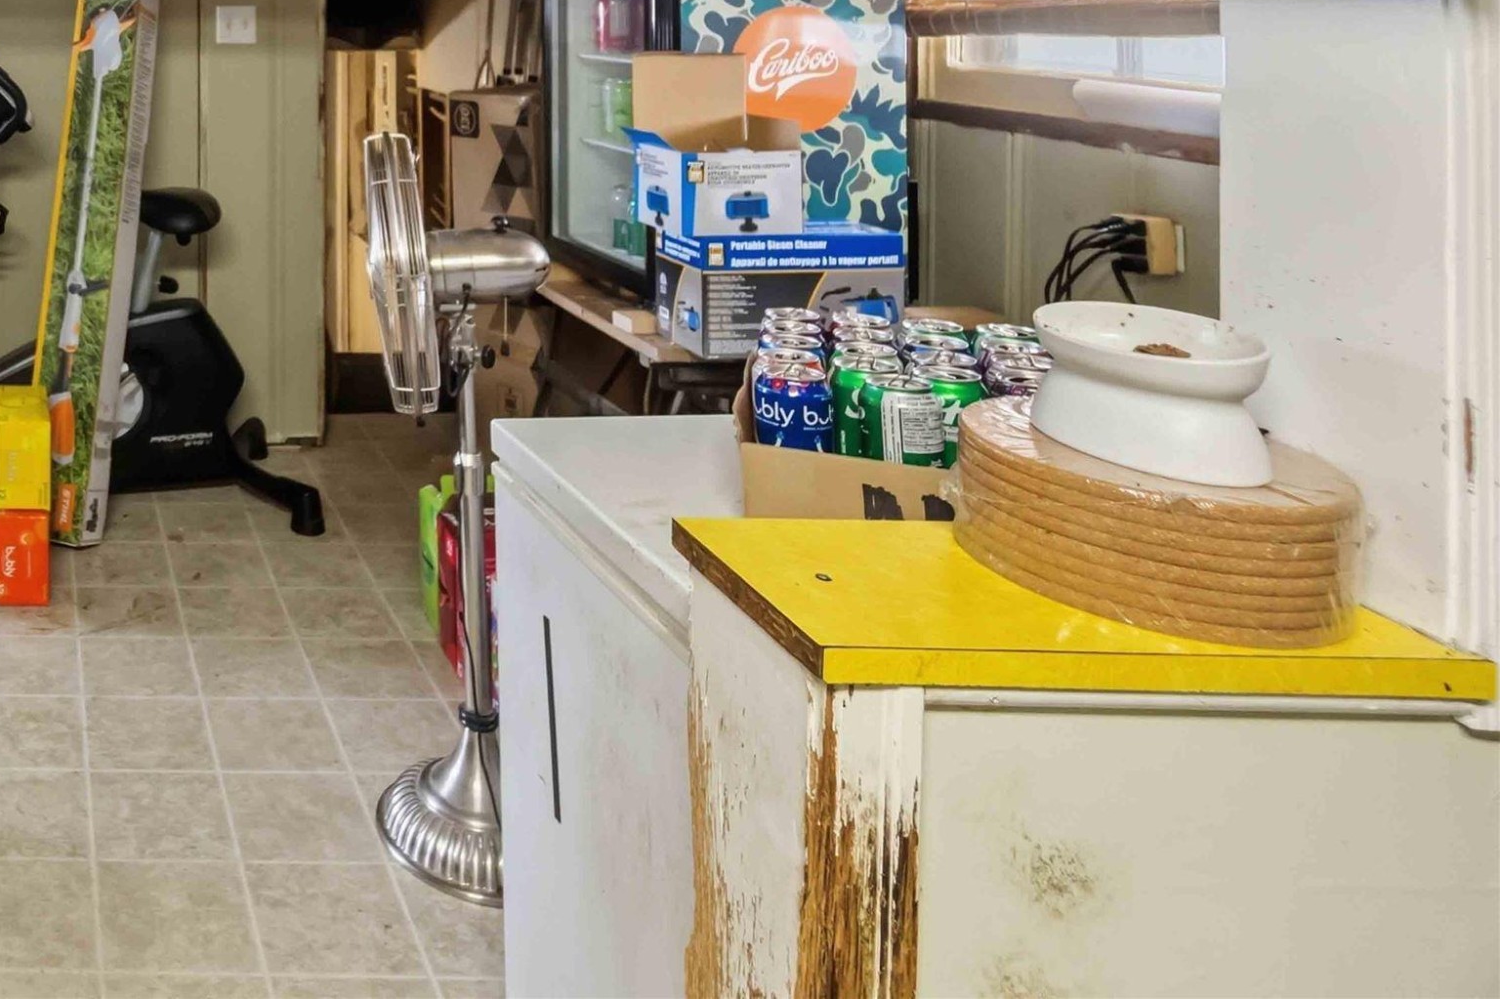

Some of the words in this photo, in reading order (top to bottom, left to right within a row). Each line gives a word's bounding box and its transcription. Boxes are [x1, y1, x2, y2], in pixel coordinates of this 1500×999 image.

[748, 38, 839, 101] Cariboo
[730, 240, 766, 251] Portable
[3, 546, 17, 577] bubly
